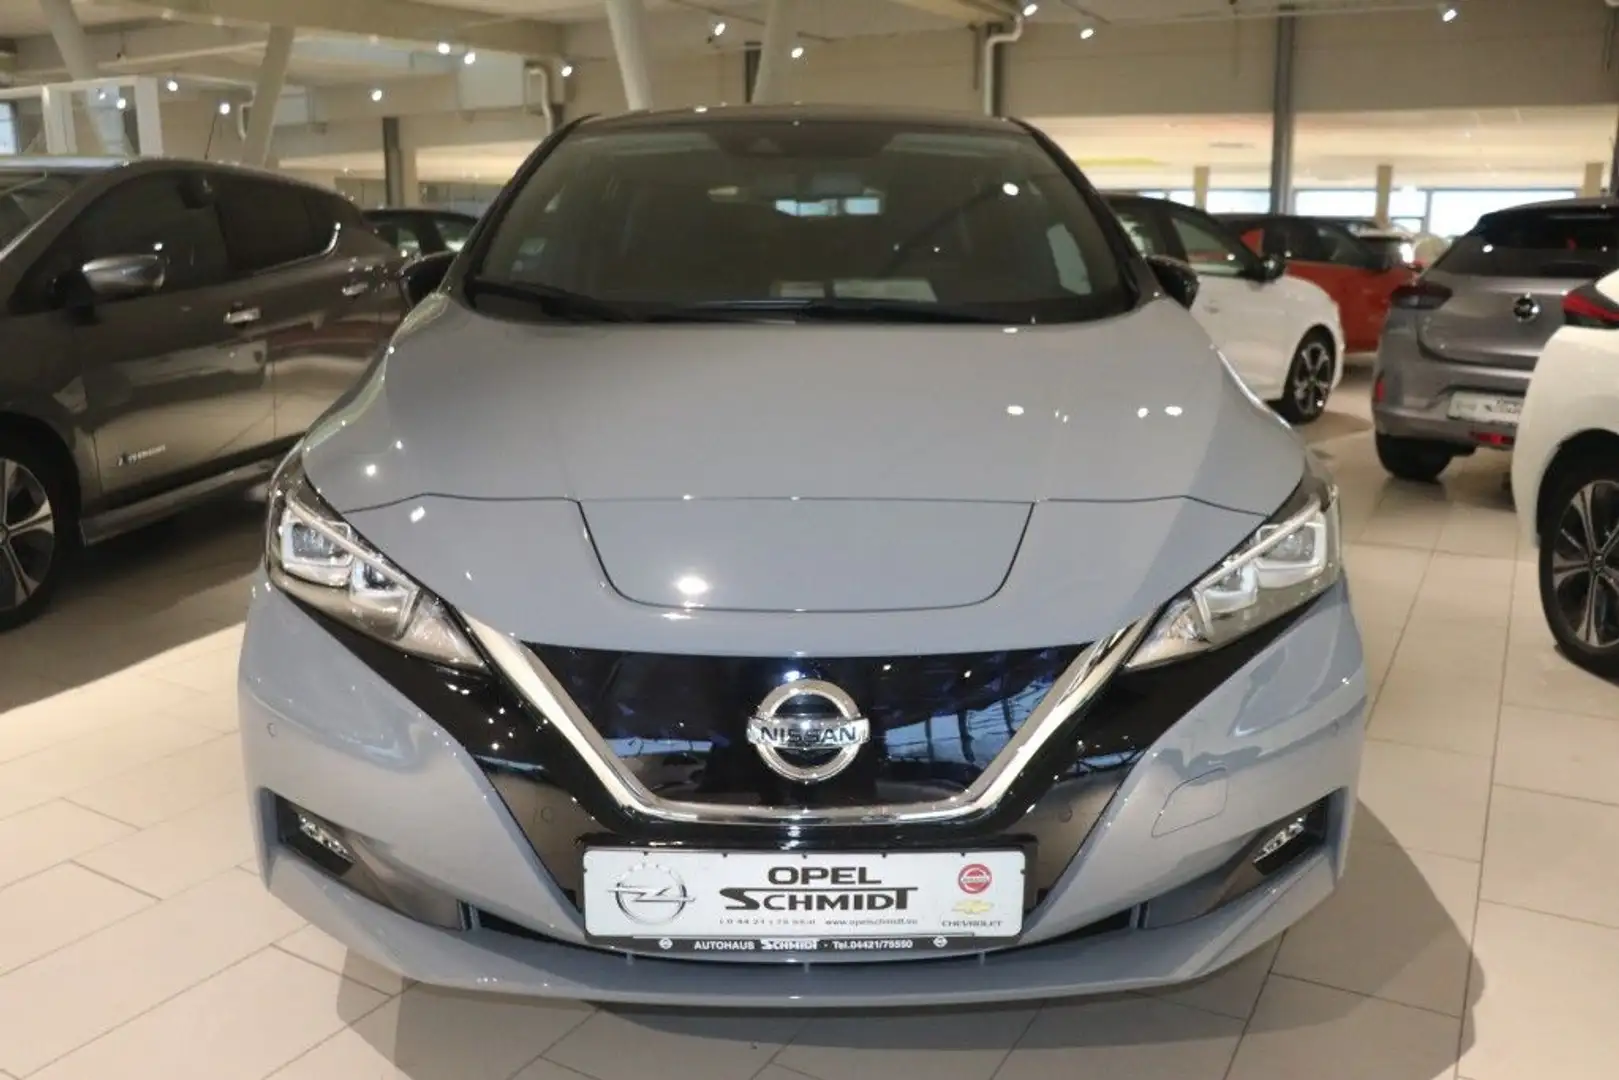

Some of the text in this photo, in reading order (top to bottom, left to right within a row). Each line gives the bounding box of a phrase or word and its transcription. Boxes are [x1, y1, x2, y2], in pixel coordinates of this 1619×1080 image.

[761, 726, 856, 743] NISSAN
[768, 866, 882, 885] OPEL
[719, 886, 919, 911] SCHMIDT
[694, 940, 755, 951] AUTOHAUS
